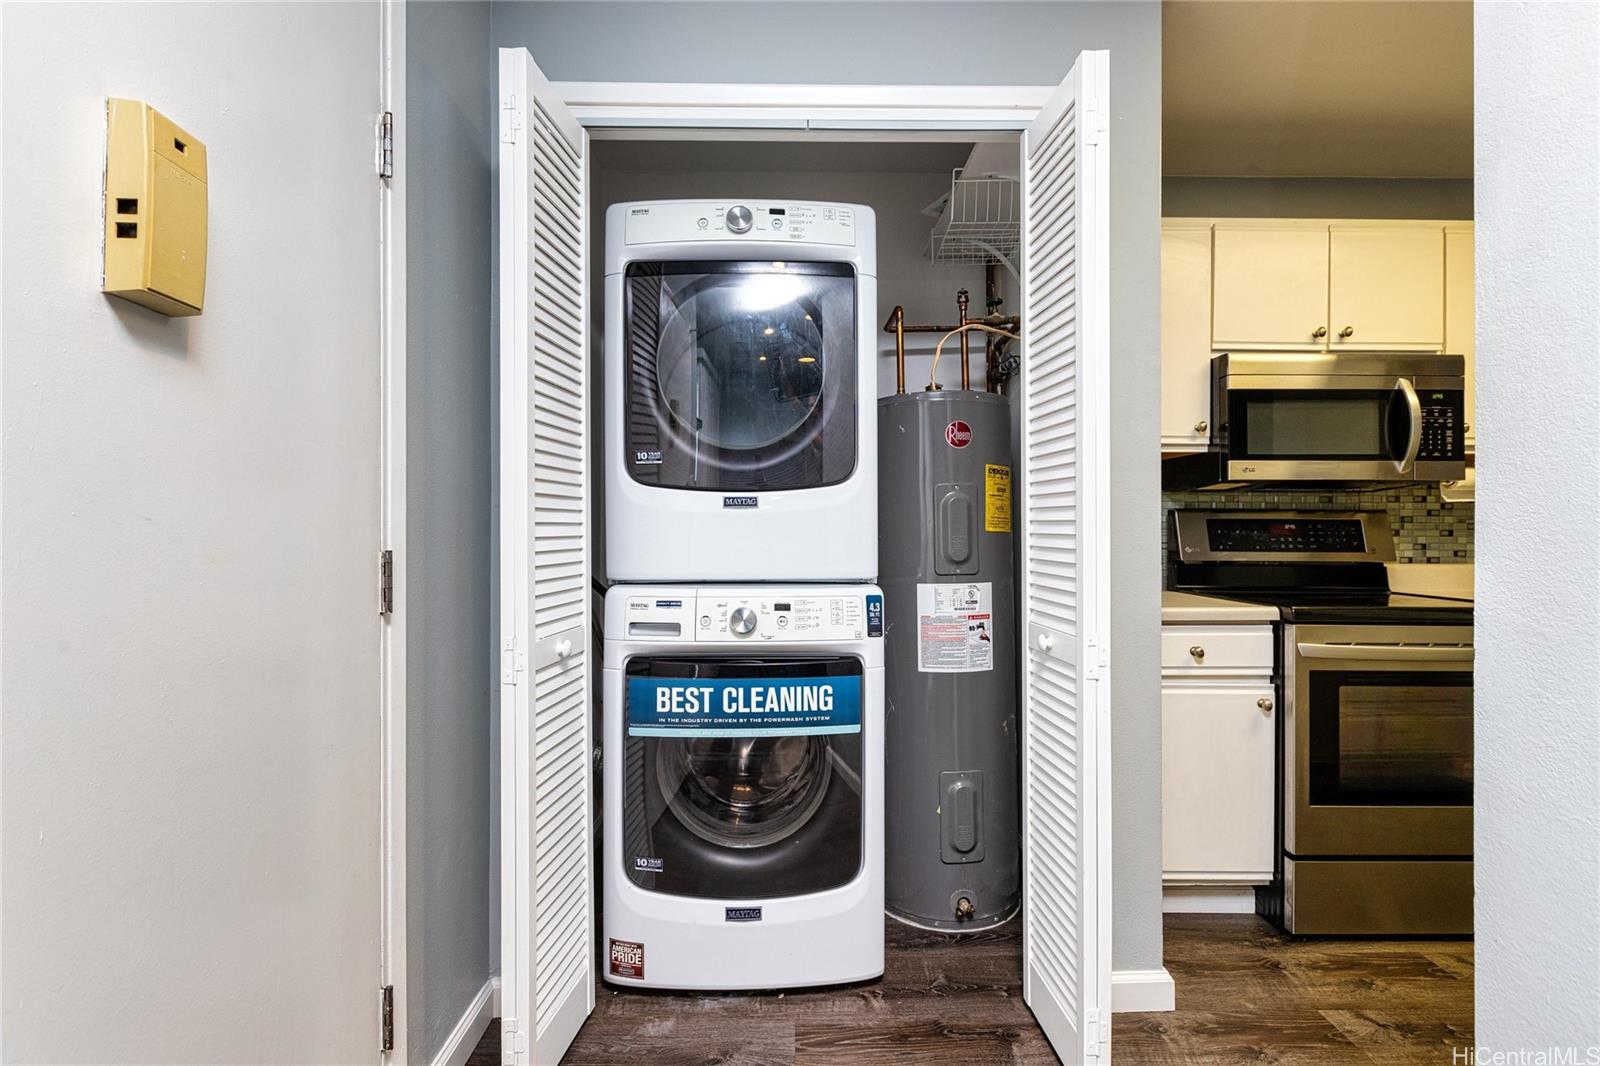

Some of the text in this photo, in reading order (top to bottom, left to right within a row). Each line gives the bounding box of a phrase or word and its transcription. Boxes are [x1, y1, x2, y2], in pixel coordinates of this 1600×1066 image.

[948, 421, 971, 444] Rheem
[637, 451, 648, 460] 10
[725, 497, 757, 506] MAYTAG
[656, 684, 834, 714] BEST CLEANING
[636, 858, 648, 866] 10
[727, 909, 760, 918] MAYTAG
[611, 944, 642, 955] AMERICAN
[611, 950, 642, 965] PRIDE
